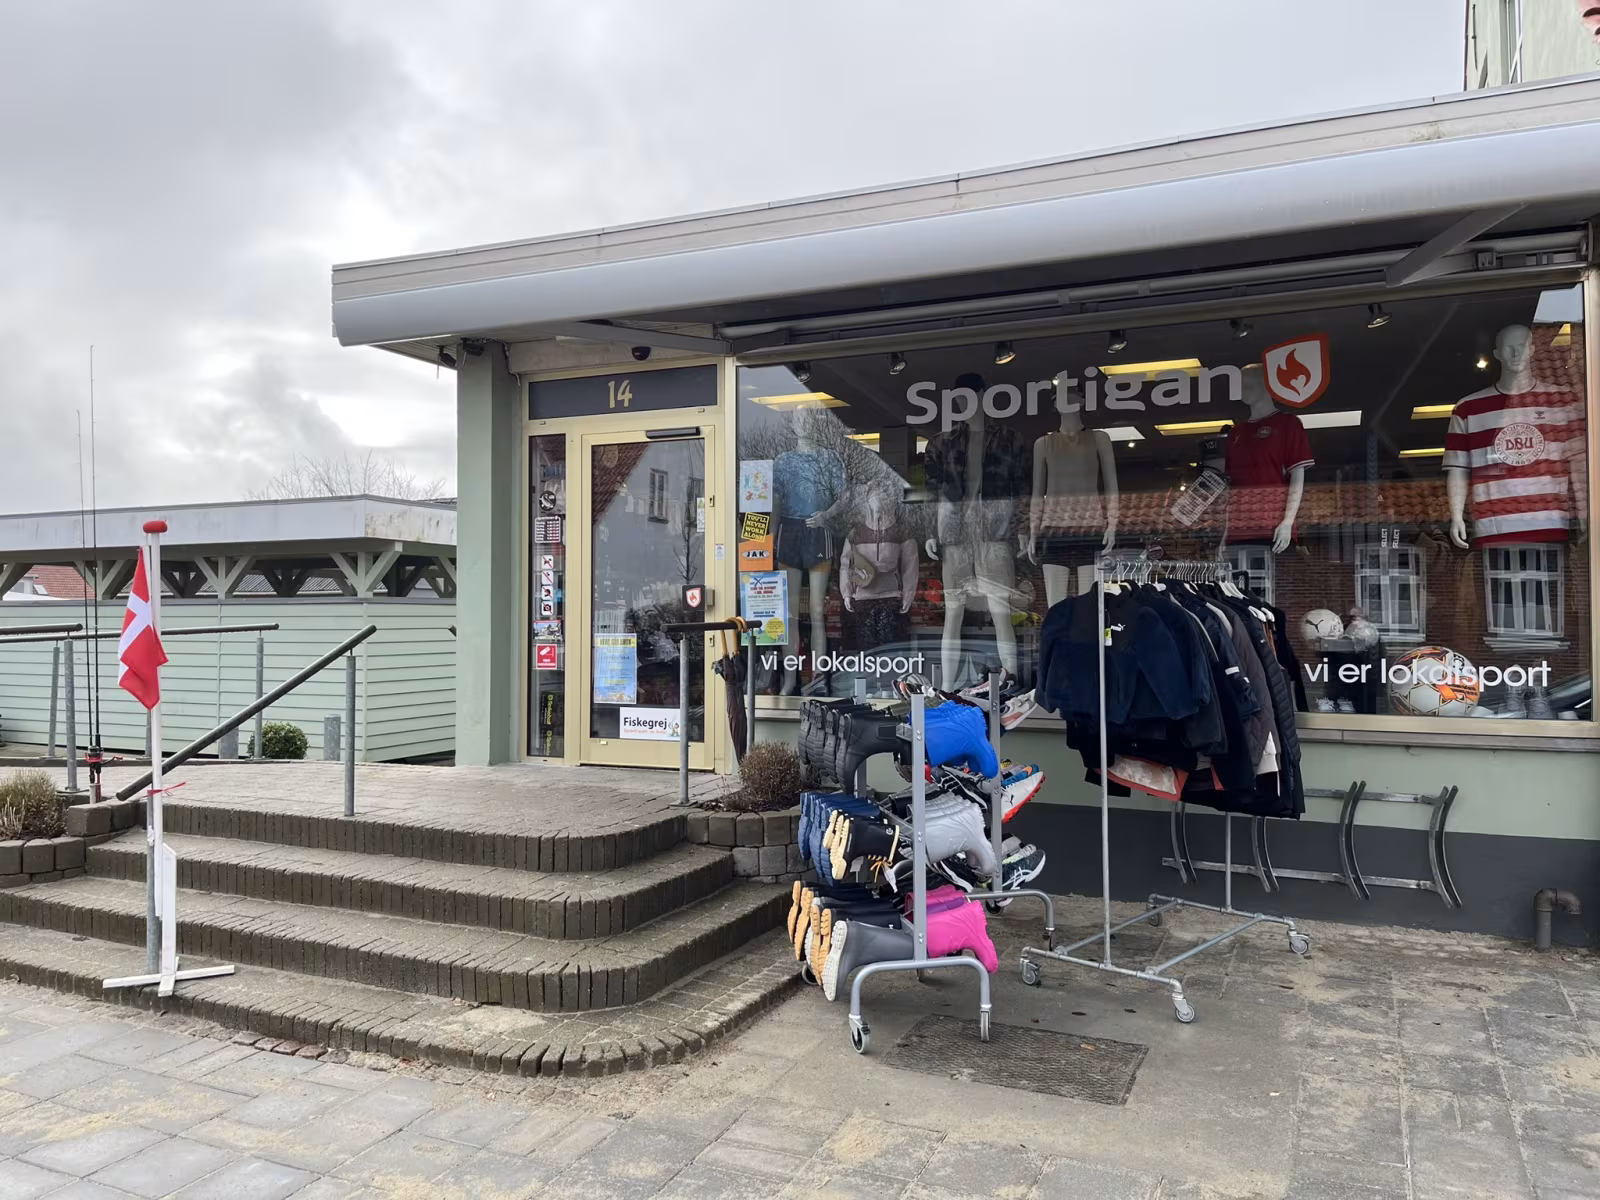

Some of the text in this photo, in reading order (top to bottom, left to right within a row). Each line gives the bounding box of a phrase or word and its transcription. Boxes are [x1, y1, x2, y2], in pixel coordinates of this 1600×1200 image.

[607, 379, 632, 408] 14
[905, 364, 1242, 432] Sportigan
[1505, 436, 1534, 451] DBU
[746, 520, 766, 529] NEVER
[747, 514, 767, 523] YOU'LL
[745, 525, 765, 534] WORK
[761, 650, 925, 678] vi er lokalsport
[1304, 657, 1329, 683] vi
[1338, 662, 1372, 684] er
[1381, 658, 1551, 692] lokalsport
[623, 717, 667, 730] Fiskegrej
